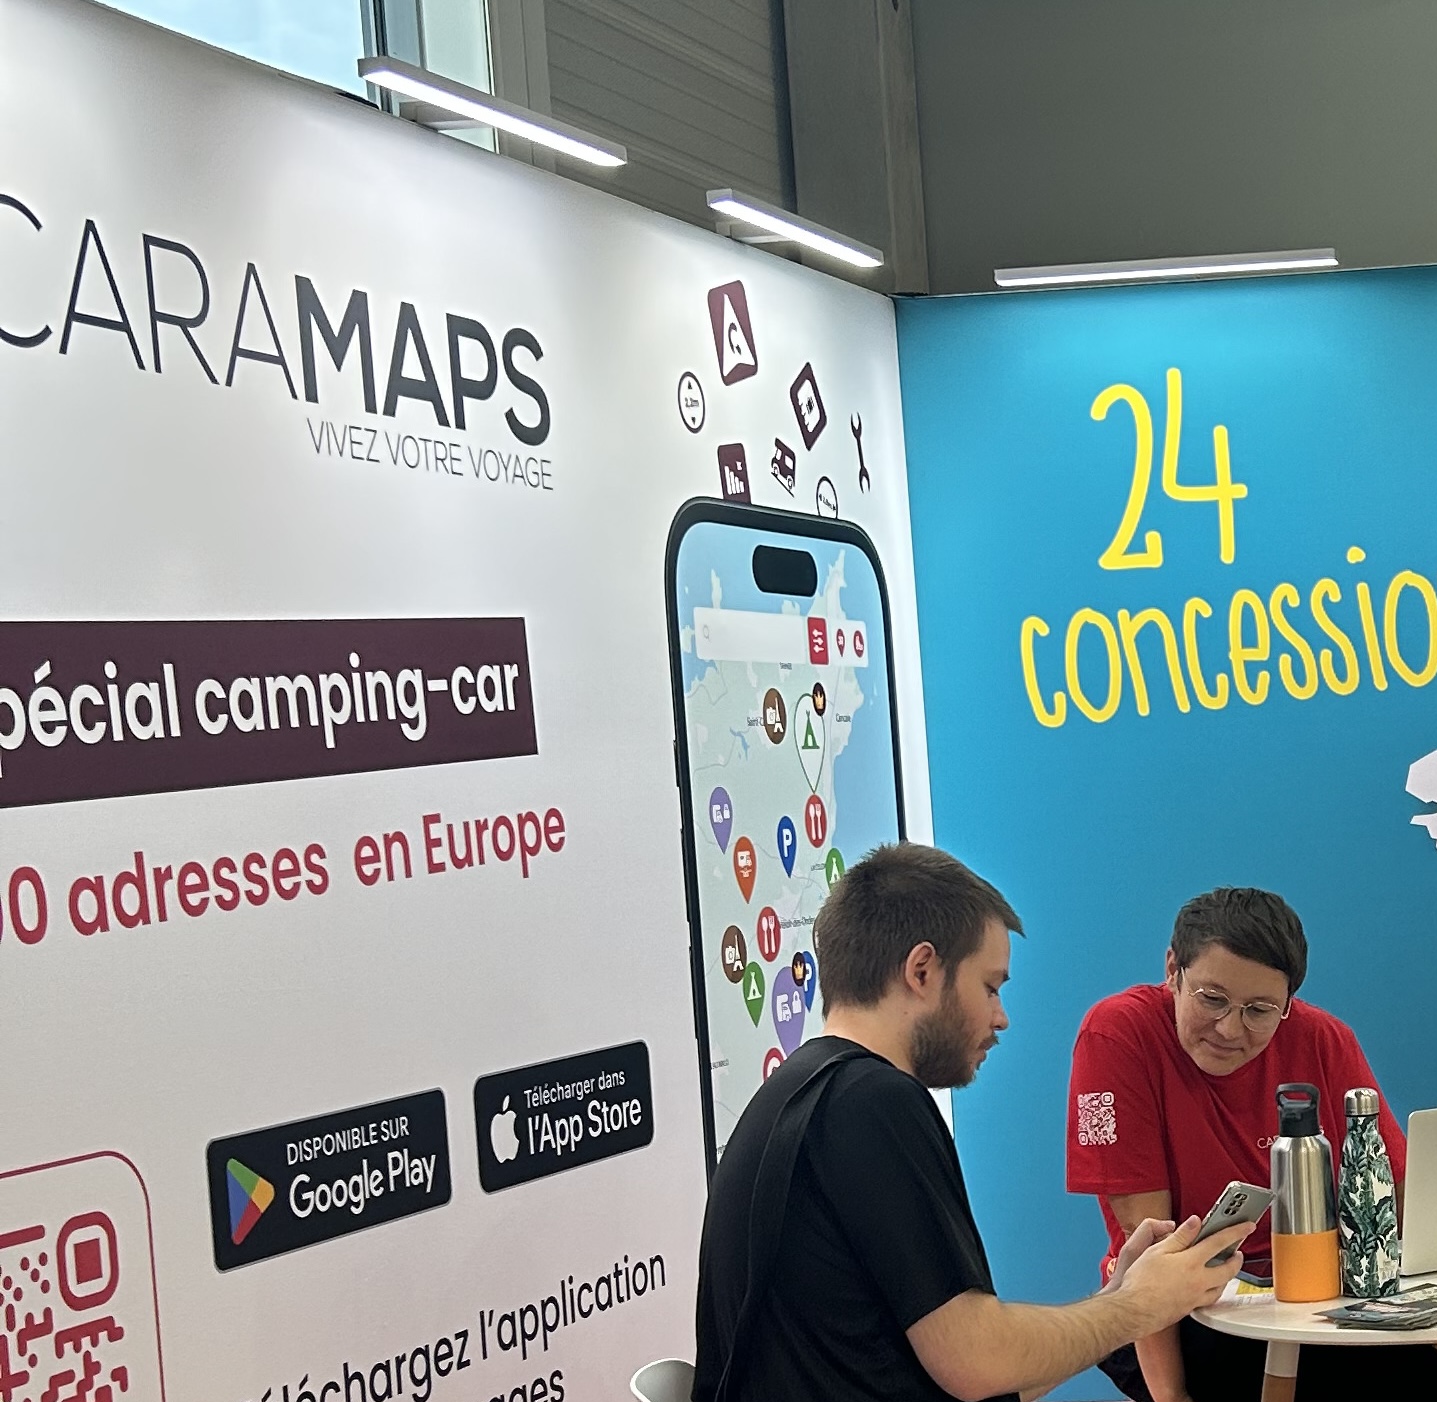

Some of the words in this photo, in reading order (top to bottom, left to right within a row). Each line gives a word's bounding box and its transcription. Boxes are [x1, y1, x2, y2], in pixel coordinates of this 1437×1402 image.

[306, 417, 380, 463] VIVEZ
[384, 431, 464, 476] VOTRE
[469, 447, 554, 491] VOYAGE
[1091, 367, 1248, 570] 24
[195, 653, 520, 748] camping-car
[0, 866, 48, 945] 0
[69, 843, 330, 936] adresses
[354, 830, 413, 886] en
[423, 807, 567, 878] Europe
[523, 1077, 595, 1109] Télécharger
[598, 1070, 625, 1092] dans
[528, 1113, 583, 1156] l'App
[587, 1097, 642, 1138] Store
[286, 1125, 378, 1165] DISPONIBLE
[381, 1116, 409, 1142] SUR
[289, 1159, 384, 1218] Google
[387, 1147, 437, 1193] Play
[479, 1254, 667, 1360] l'application
